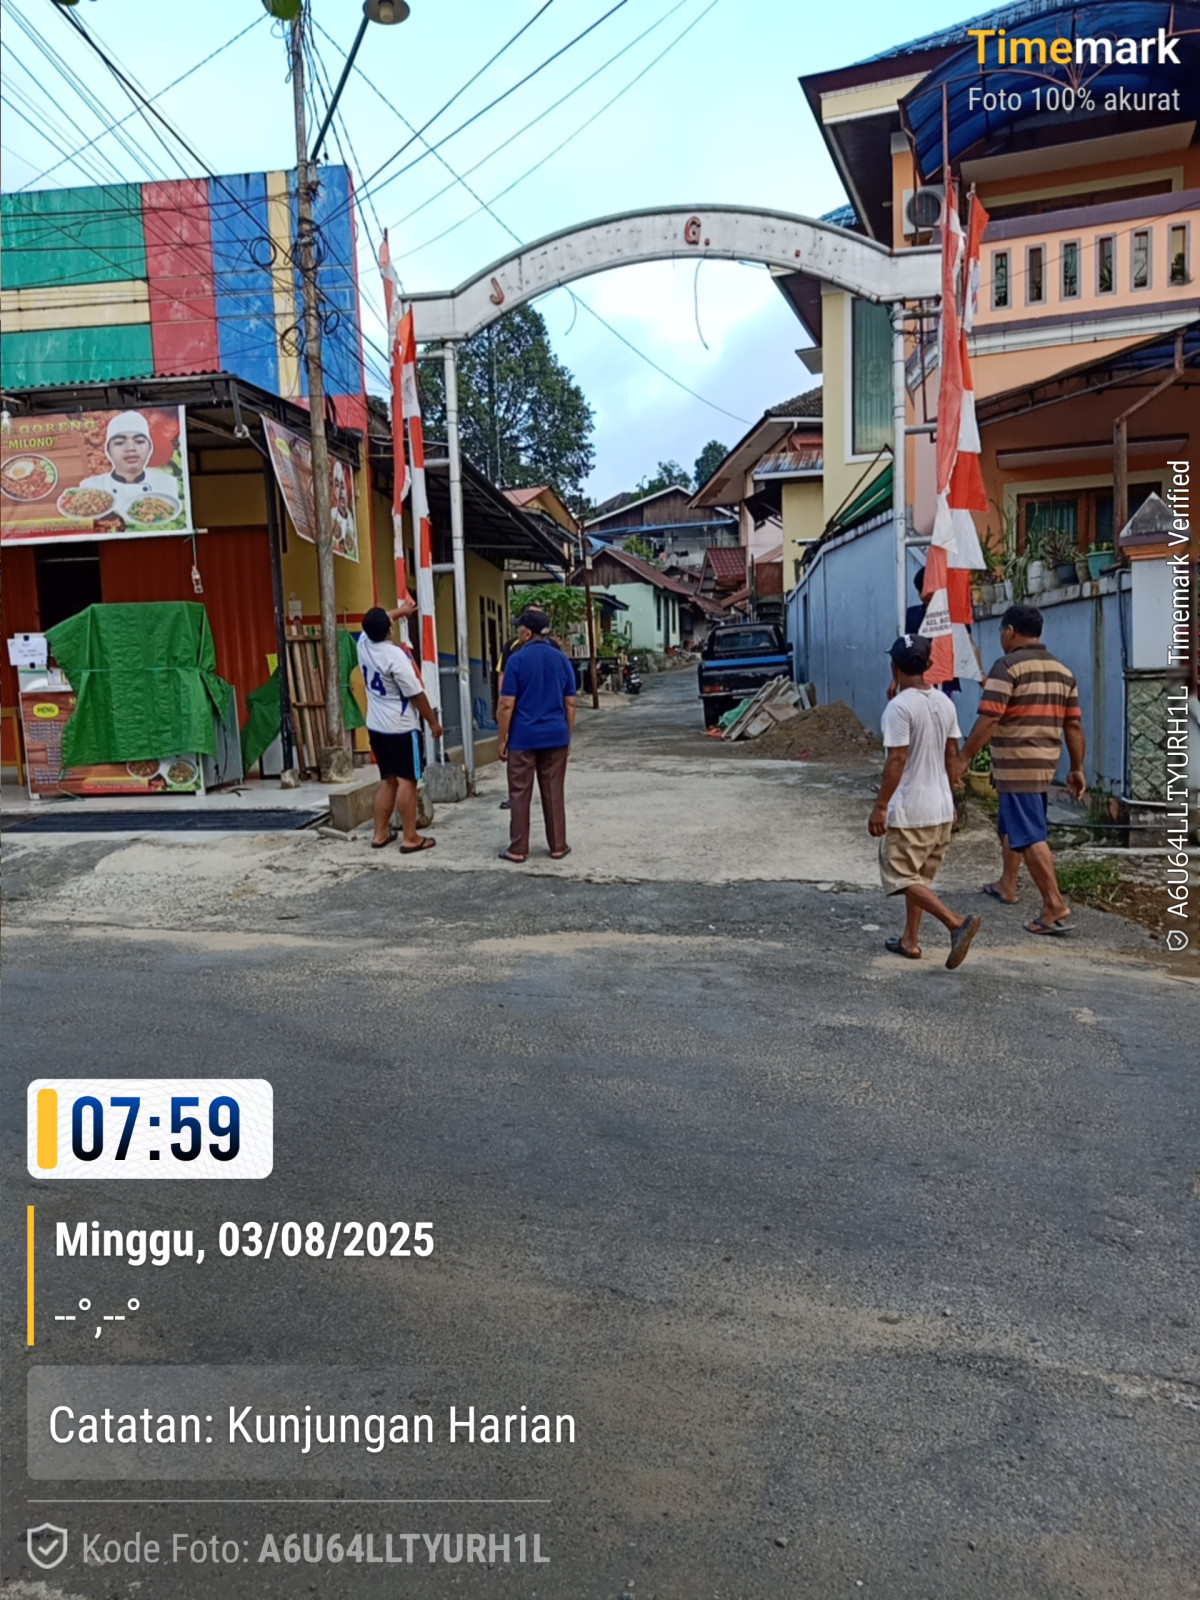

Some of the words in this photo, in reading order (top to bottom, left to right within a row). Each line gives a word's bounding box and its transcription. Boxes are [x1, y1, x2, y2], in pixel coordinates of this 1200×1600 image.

[19, 419, 96, 435] GORENG
[362, 665, 386, 696] 14
[36, 705, 56, 714] MENU
